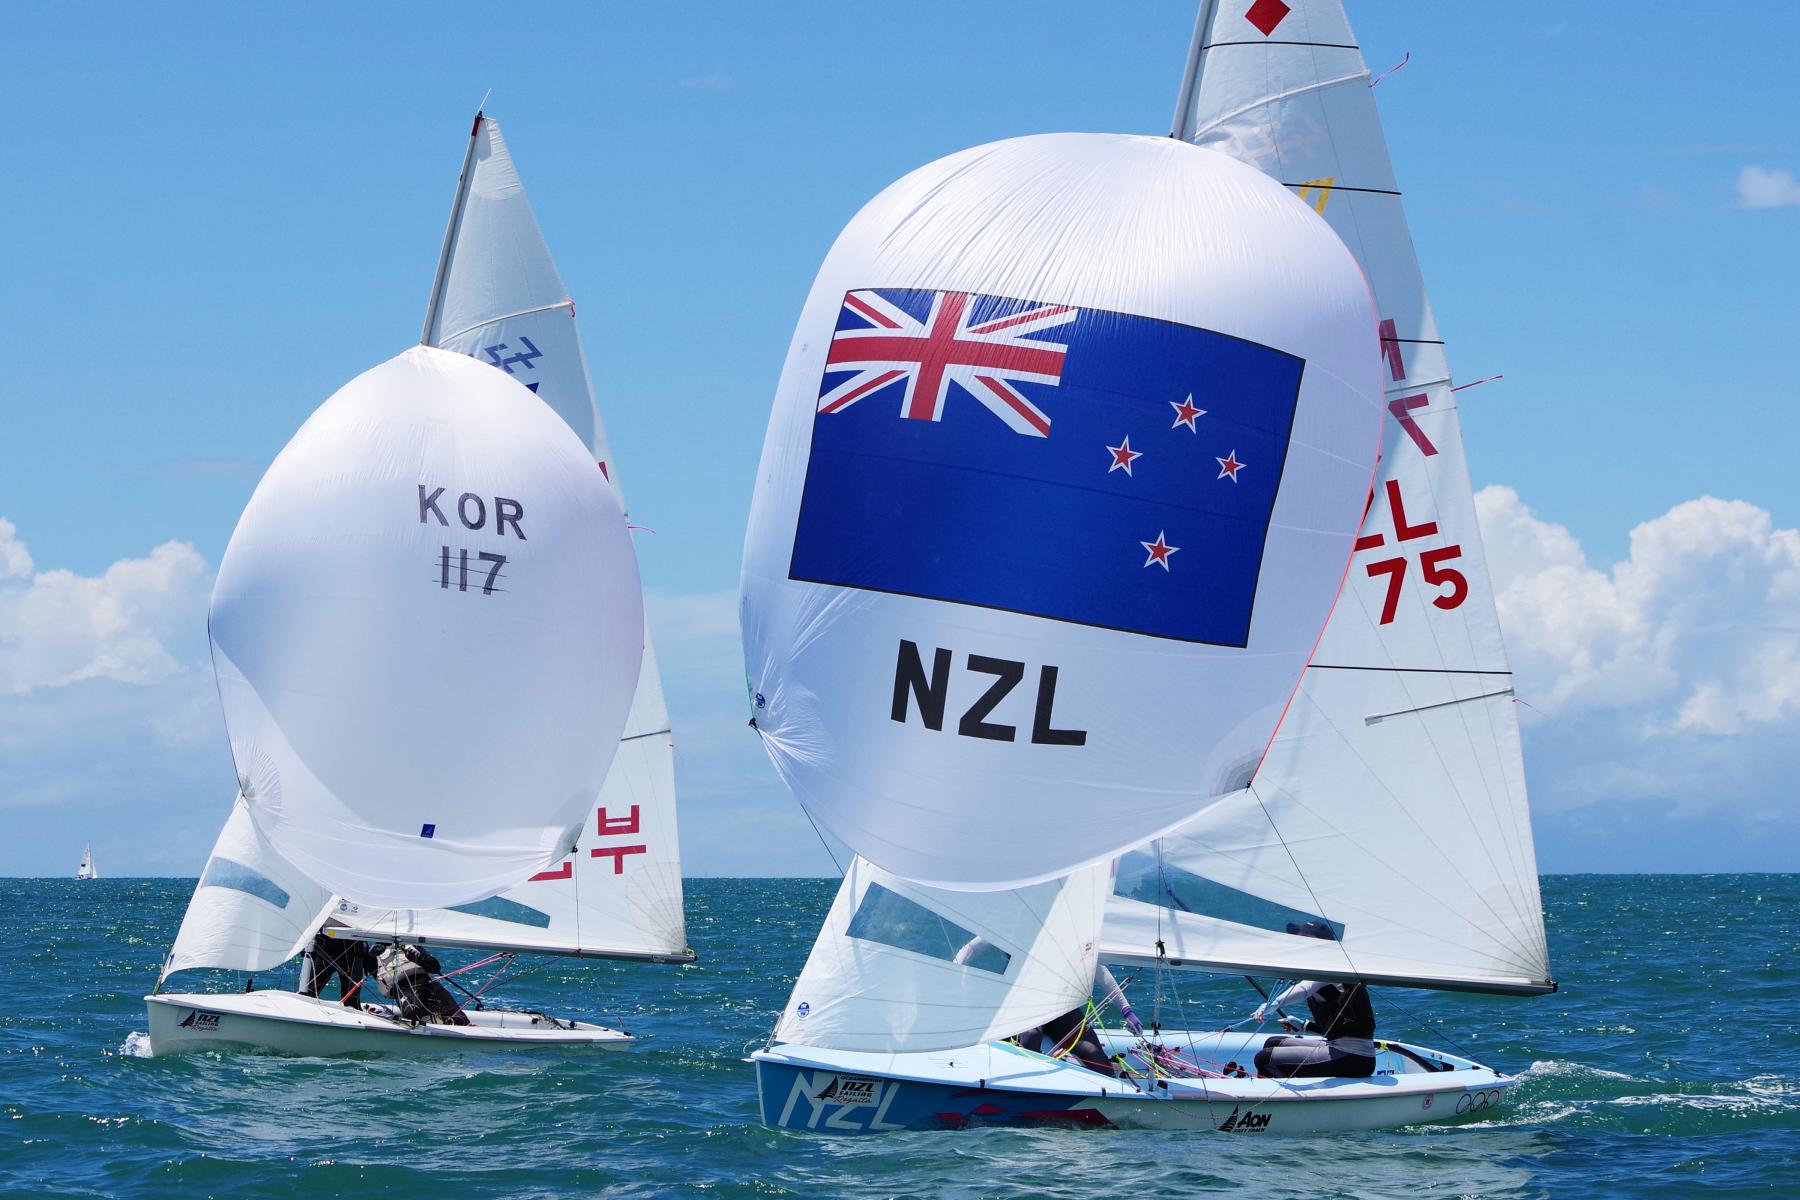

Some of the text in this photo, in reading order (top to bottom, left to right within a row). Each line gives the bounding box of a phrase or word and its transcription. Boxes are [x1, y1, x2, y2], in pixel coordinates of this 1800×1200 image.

[418, 484, 527, 541] KOR
[441, 545, 507, 596] 117
[1366, 544, 1468, 625] 75
[890, 638, 1088, 746] NZL
[838, 1090, 873, 1098] SAILING
